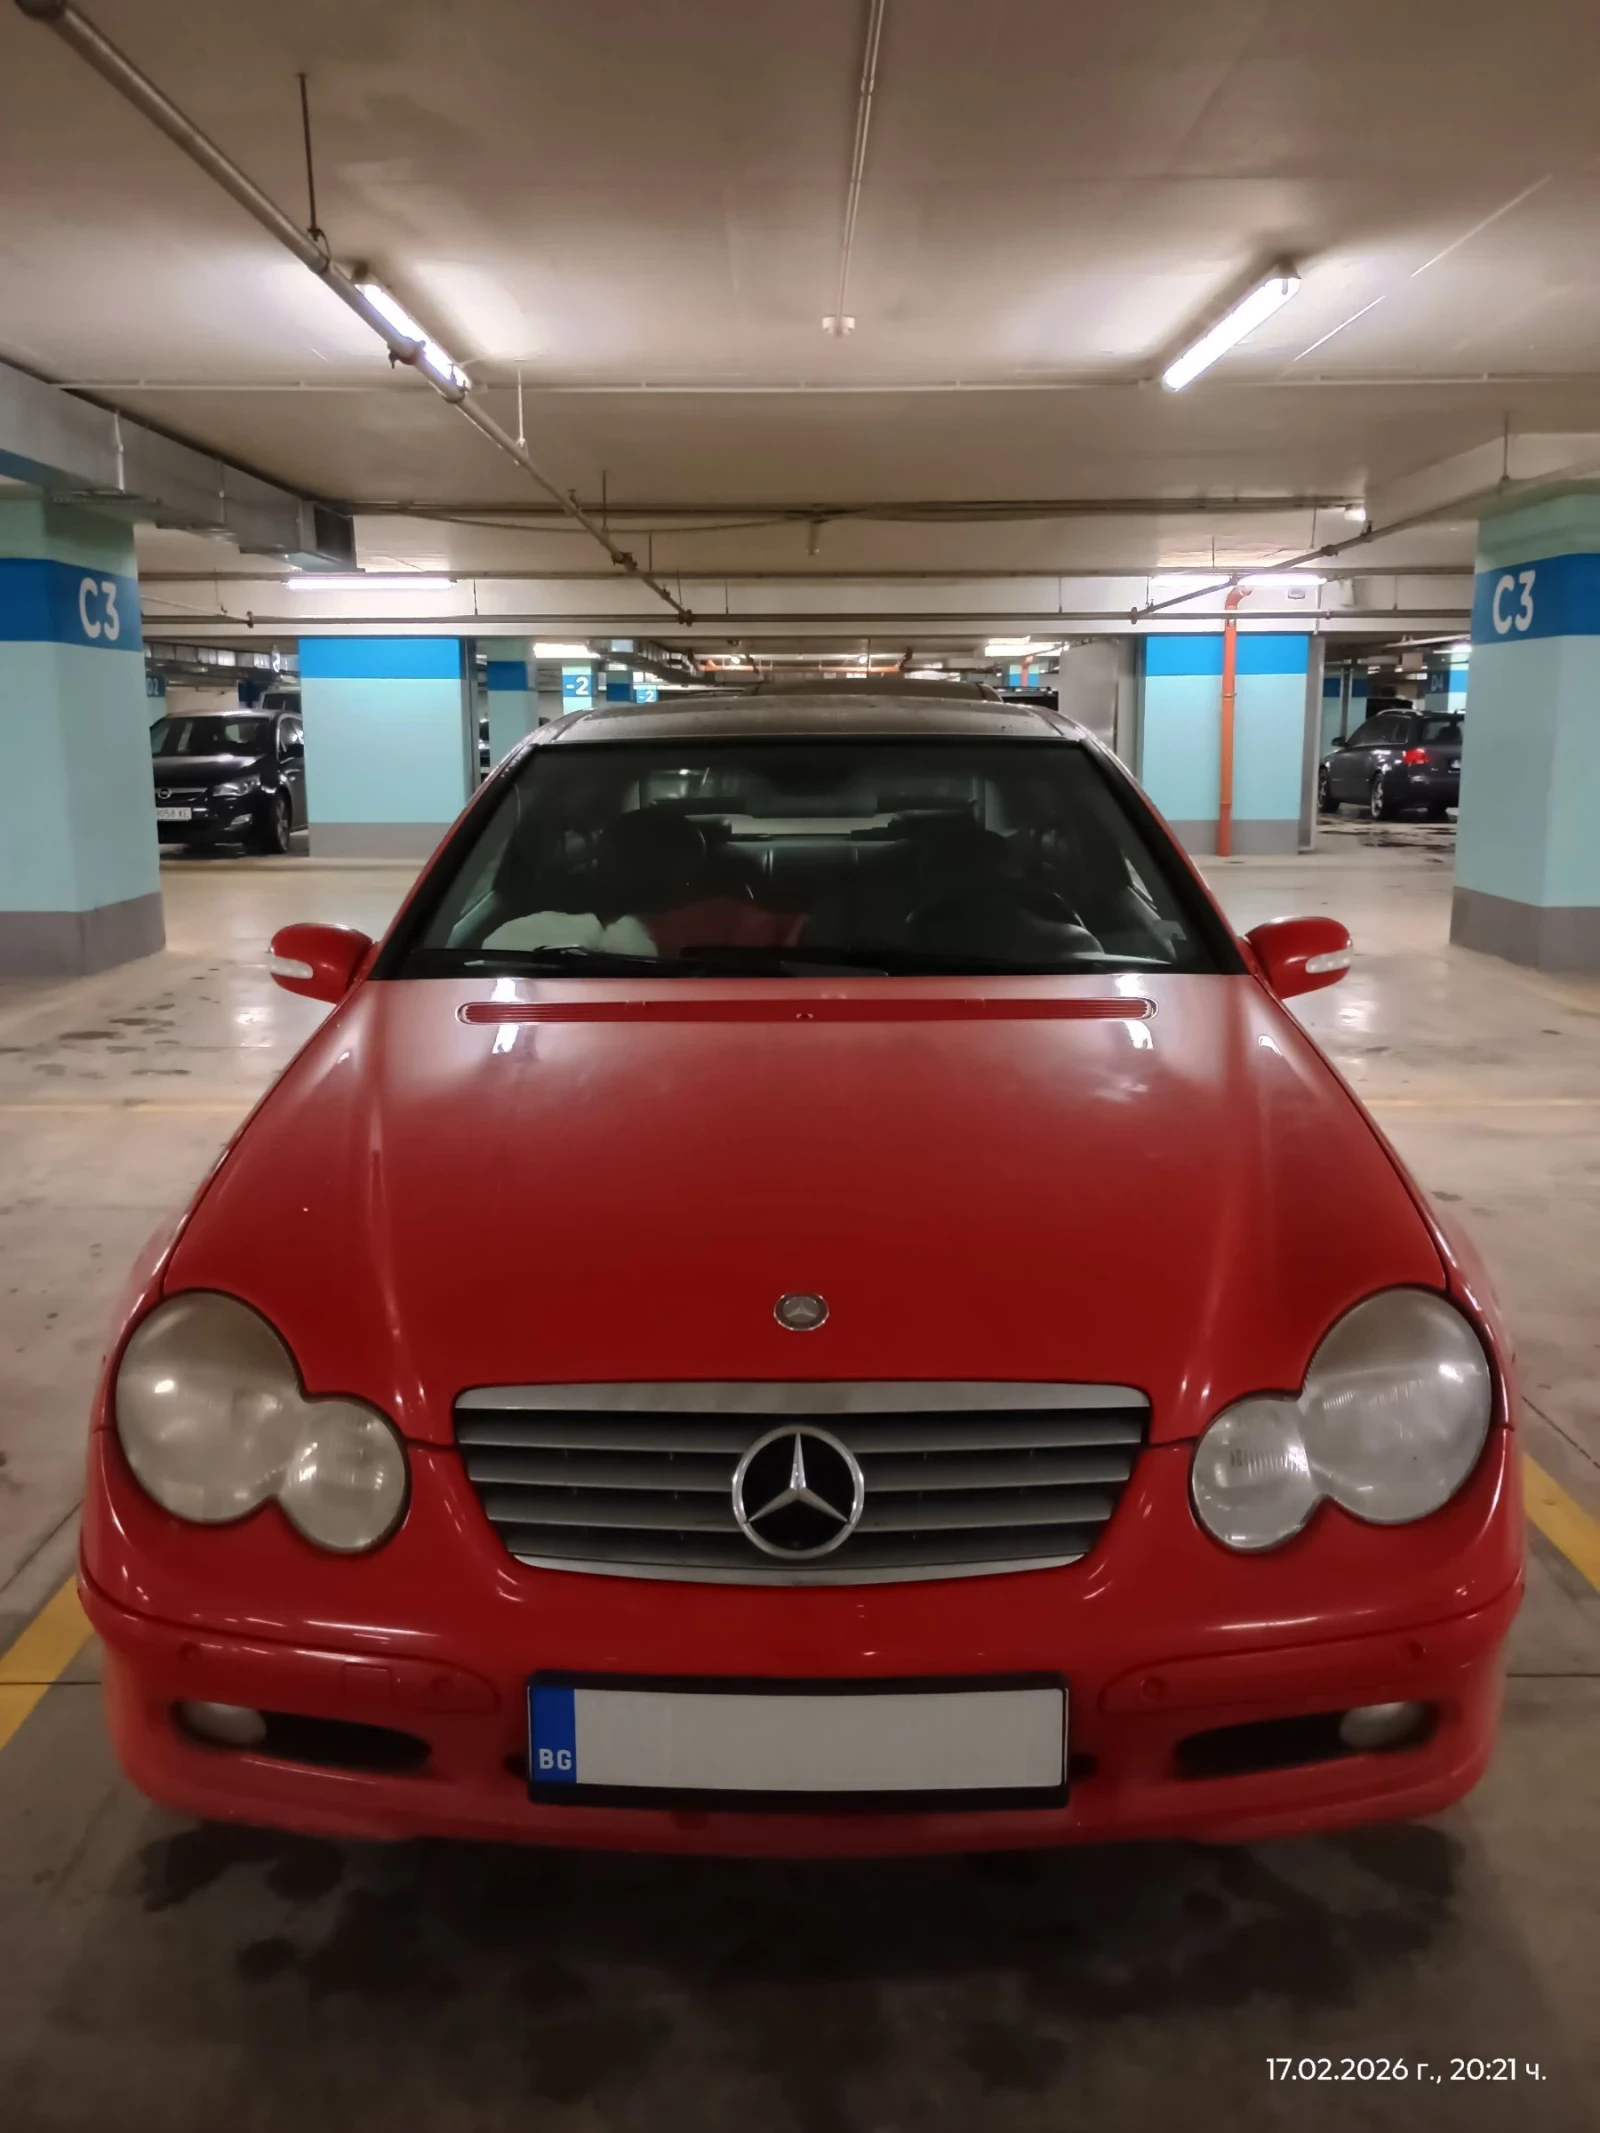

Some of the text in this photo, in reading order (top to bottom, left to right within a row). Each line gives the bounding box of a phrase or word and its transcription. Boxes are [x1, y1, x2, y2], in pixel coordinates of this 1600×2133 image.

[79, 577, 120, 641] C3
[1492, 570, 1536, 635] C3
[565, 676, 589, 695] -2
[638, 690, 655, 703] -2
[539, 1748, 572, 1770] BG
